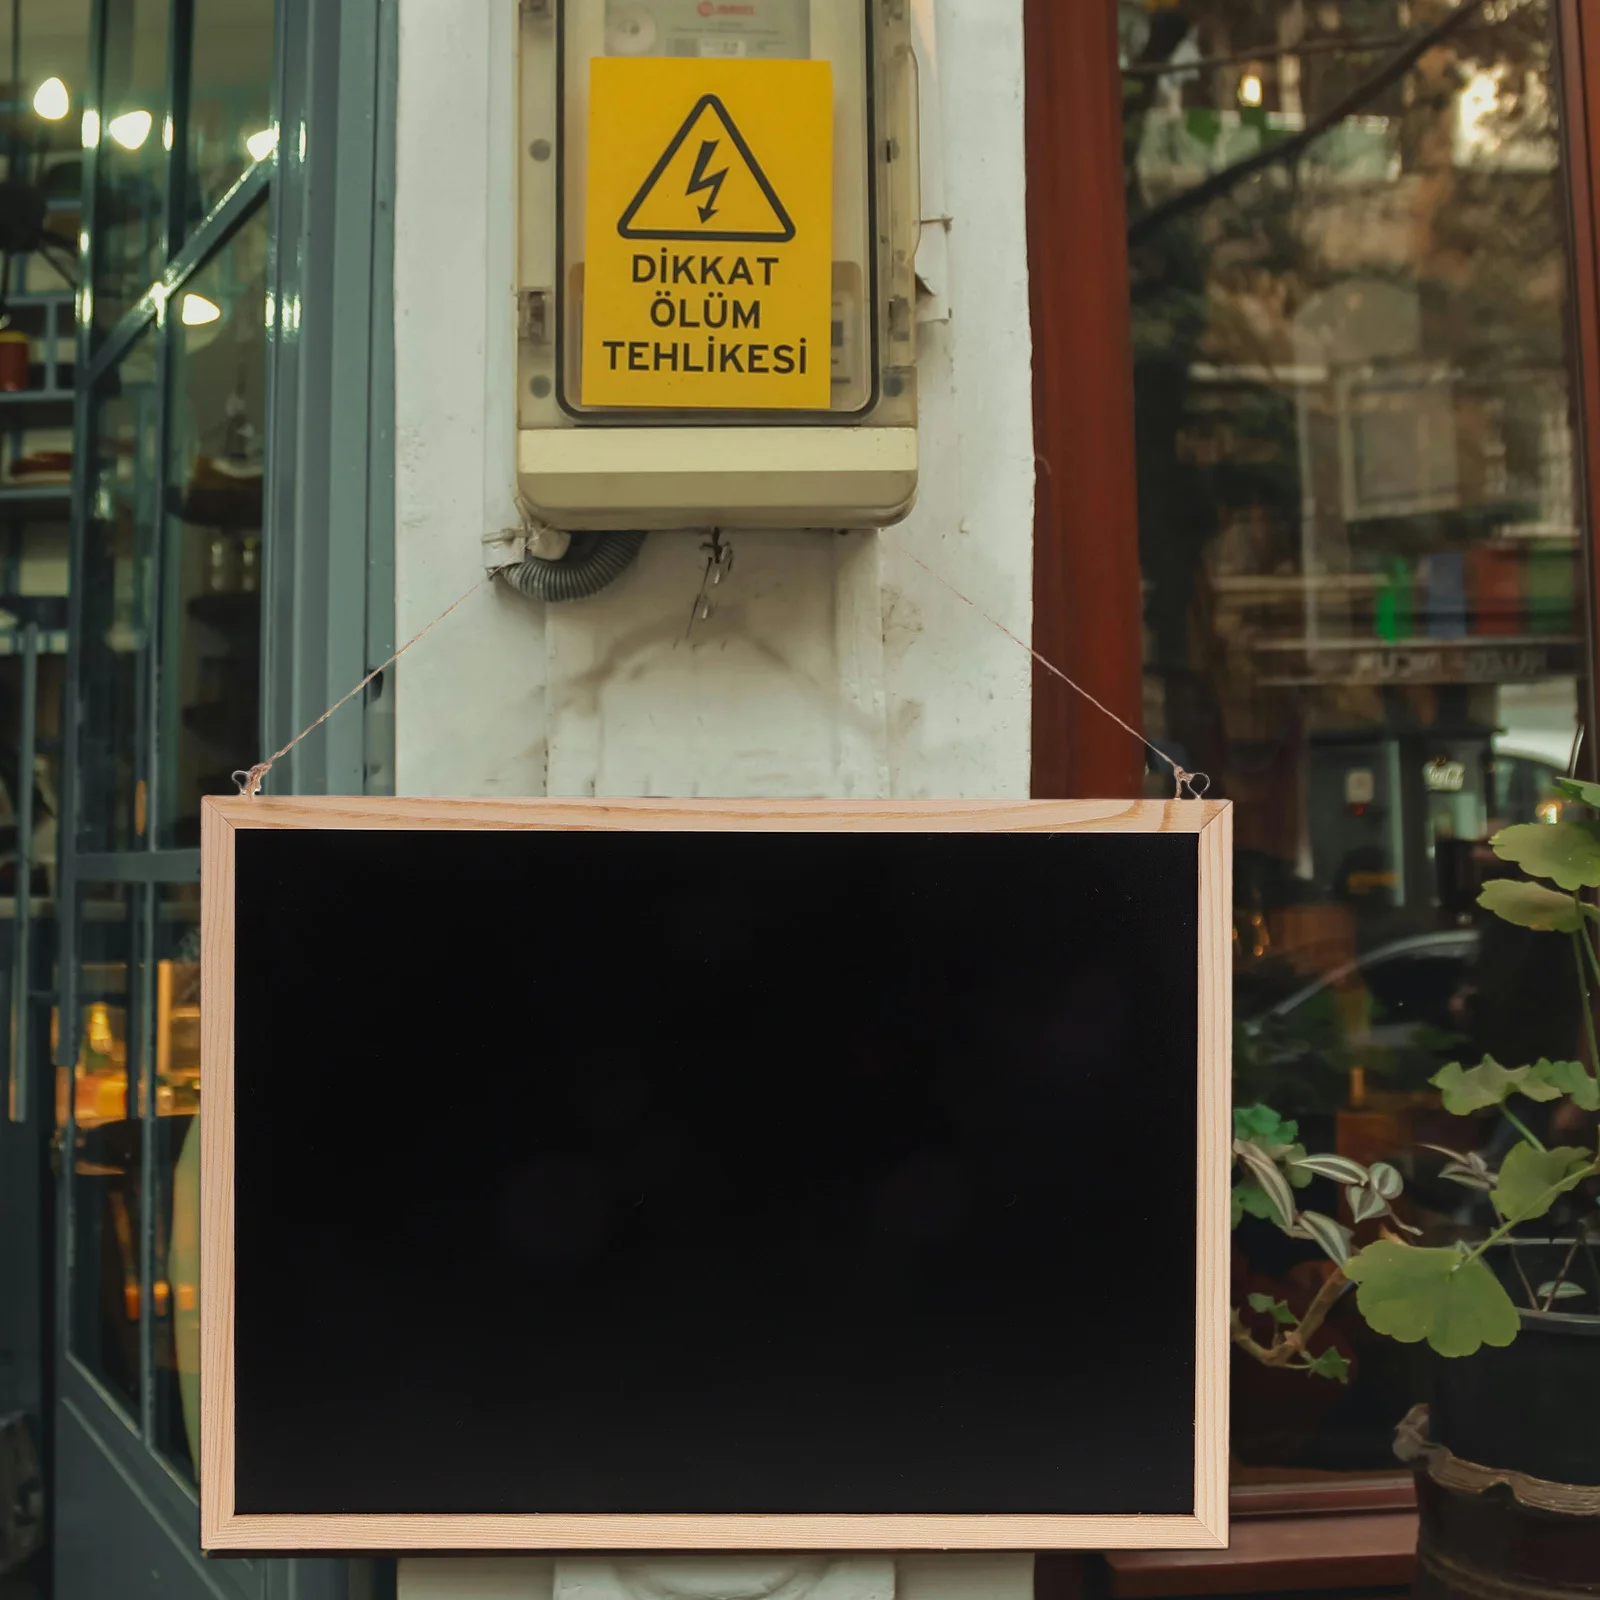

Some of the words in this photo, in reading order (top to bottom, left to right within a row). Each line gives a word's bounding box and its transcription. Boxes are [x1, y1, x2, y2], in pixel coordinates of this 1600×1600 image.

[632, 247, 779, 286] DİKKAT
[650, 291, 760, 329] ÖLÜM
[603, 336, 807, 375] TEHLİKESİ
